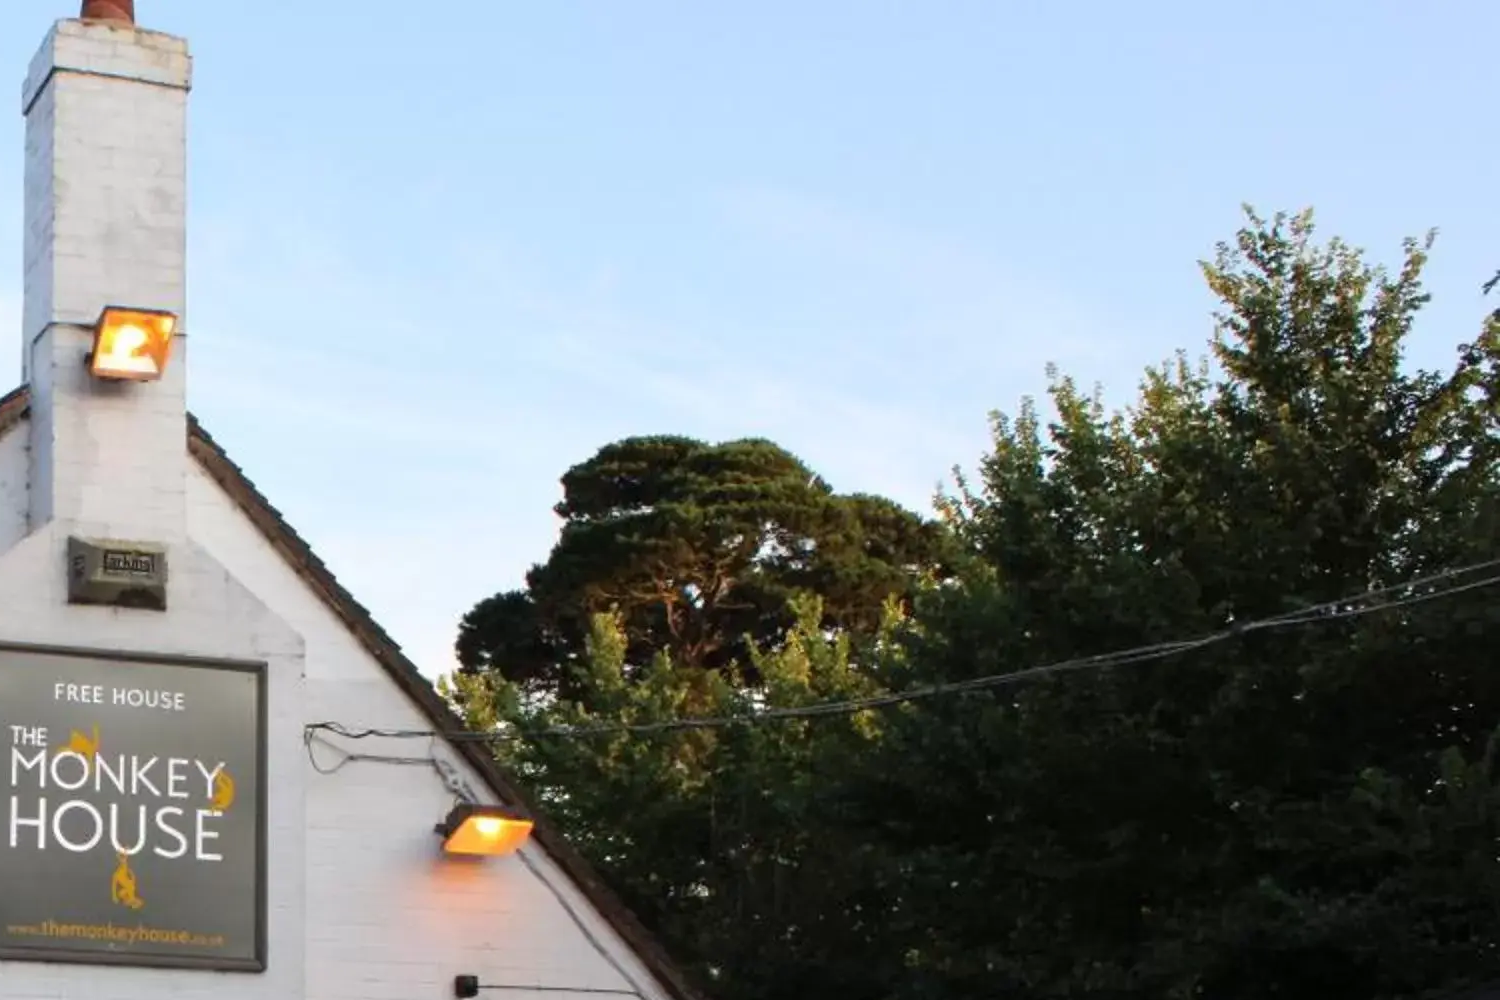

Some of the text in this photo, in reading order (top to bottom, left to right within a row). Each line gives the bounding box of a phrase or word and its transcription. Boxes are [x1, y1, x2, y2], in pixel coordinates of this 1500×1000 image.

[54, 683, 186, 711] FREE HOUSE
[10, 724, 48, 747] THE
[10, 747, 226, 800] MONKEY
[9, 796, 223, 862] HOUSE
